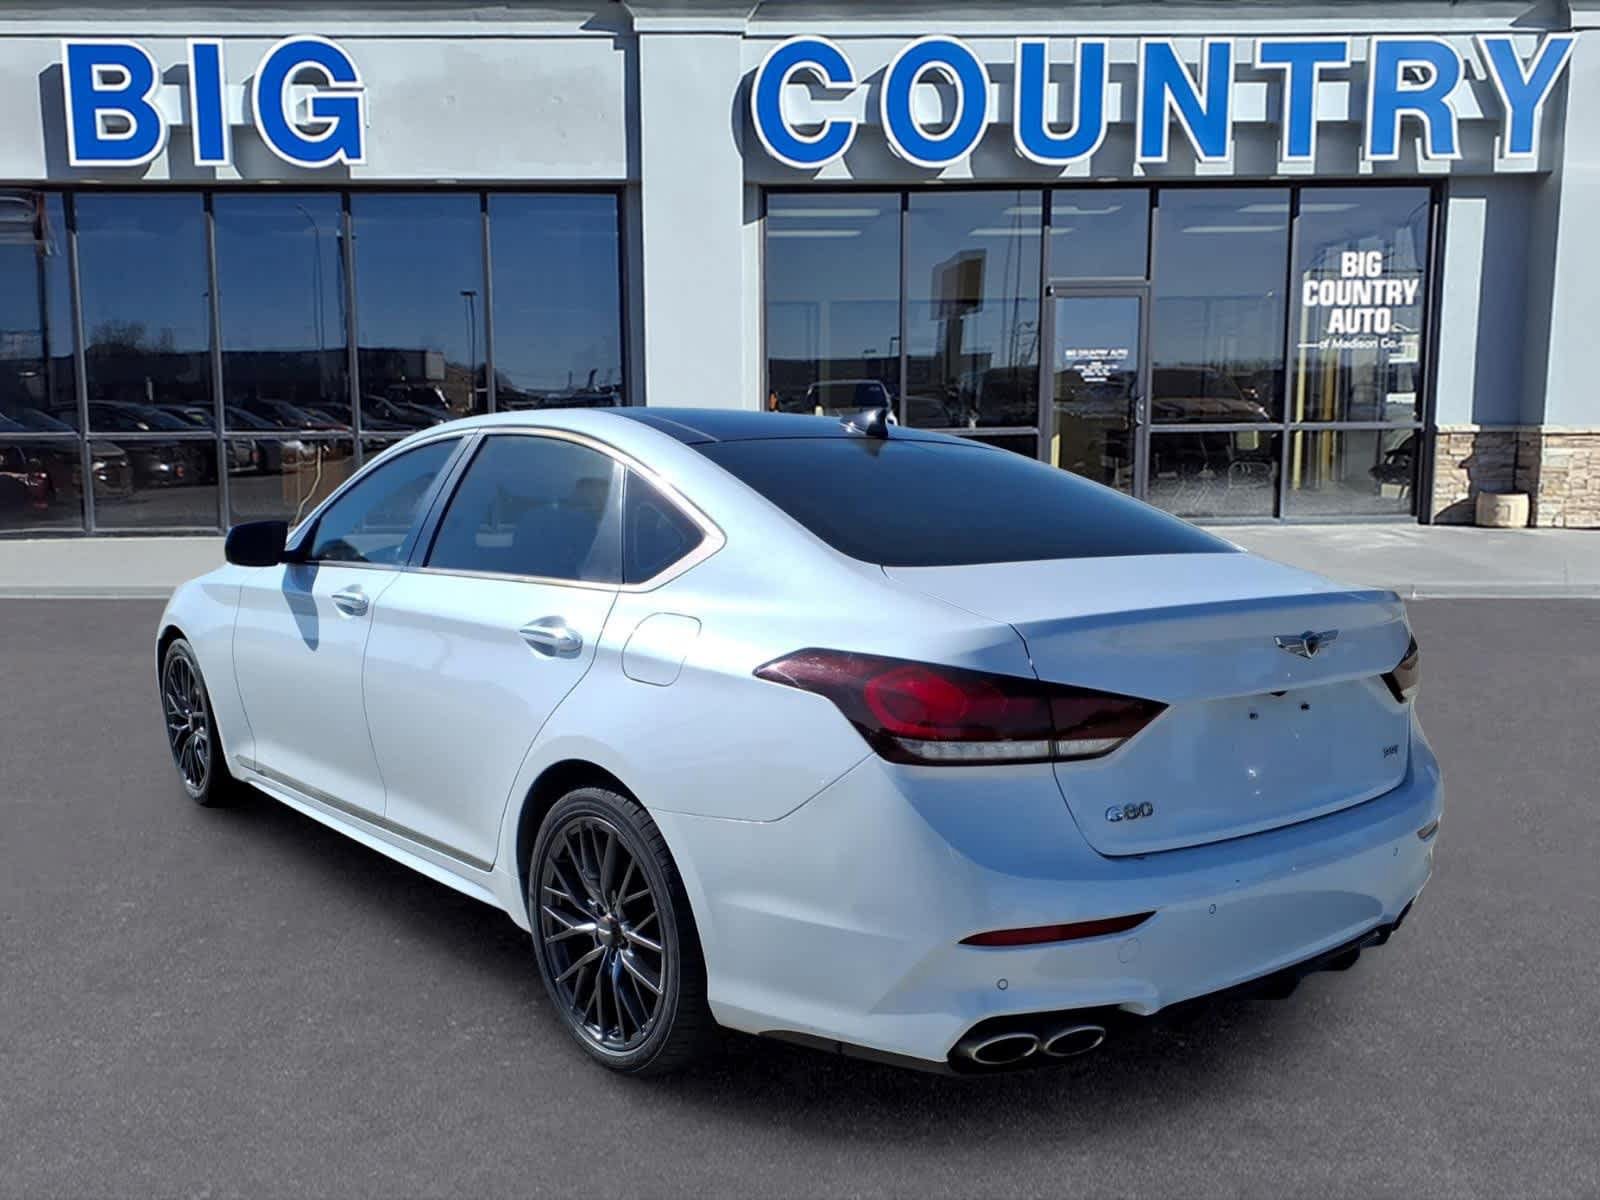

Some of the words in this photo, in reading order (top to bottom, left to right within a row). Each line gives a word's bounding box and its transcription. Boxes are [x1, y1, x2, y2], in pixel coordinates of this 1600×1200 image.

[61, 35, 366, 167] BIG
[751, 33, 1574, 169] COUNTRY
[1341, 251, 1382, 278] BIG
[1303, 279, 1419, 306] COUNTRY
[1328, 308, 1391, 334] AUTO
[1332, 339, 1378, 349] Madison
[1105, 801, 1154, 822] G80
